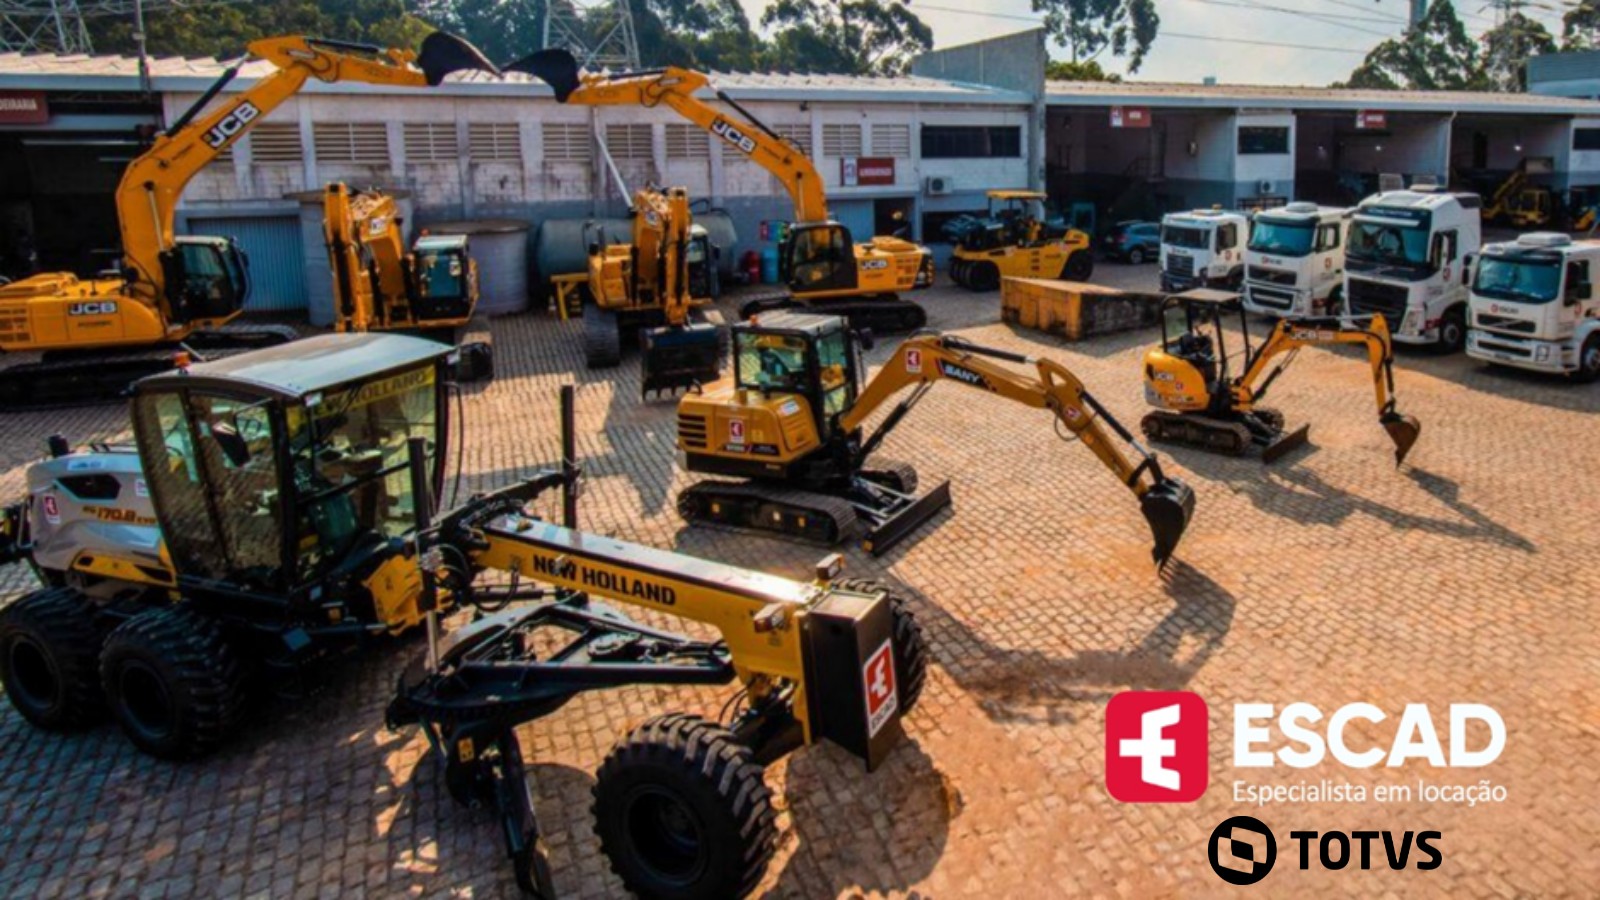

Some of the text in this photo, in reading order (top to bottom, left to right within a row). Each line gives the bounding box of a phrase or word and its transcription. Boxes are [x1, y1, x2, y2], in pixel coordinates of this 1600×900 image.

[209, 101, 259, 148] JCB
[711, 122, 756, 153] JCB
[861, 259, 887, 270] JCB
[69, 302, 116, 315] JCB
[943, 363, 980, 384] SANY
[582, 565, 677, 606] HOLLAND
